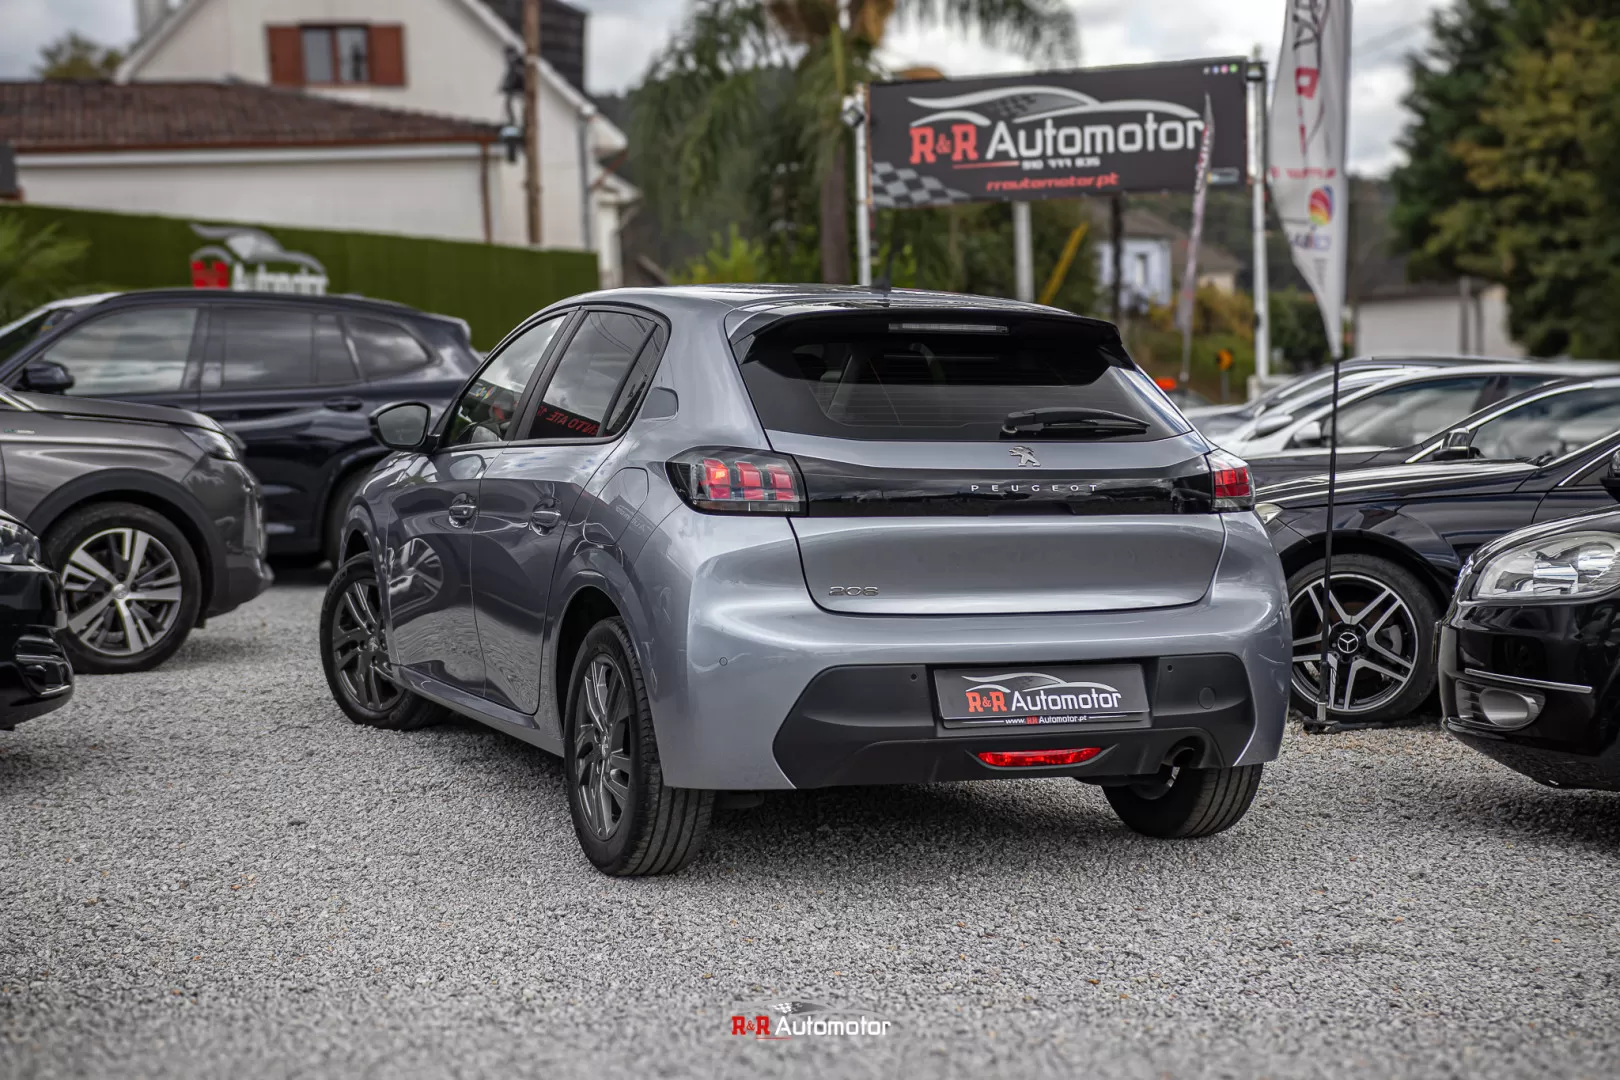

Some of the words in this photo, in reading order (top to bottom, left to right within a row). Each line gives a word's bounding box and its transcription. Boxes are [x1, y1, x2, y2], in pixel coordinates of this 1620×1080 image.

[909, 123, 979, 164] R&R
[985, 112, 1205, 160] Automotor
[986, 172, 1120, 192] rrautomotor.pt
[970, 484, 1097, 492] PEUGEOT
[829, 586, 879, 596] 208
[965, 691, 1008, 713] R&R
[1011, 688, 1122, 712] Automotor
